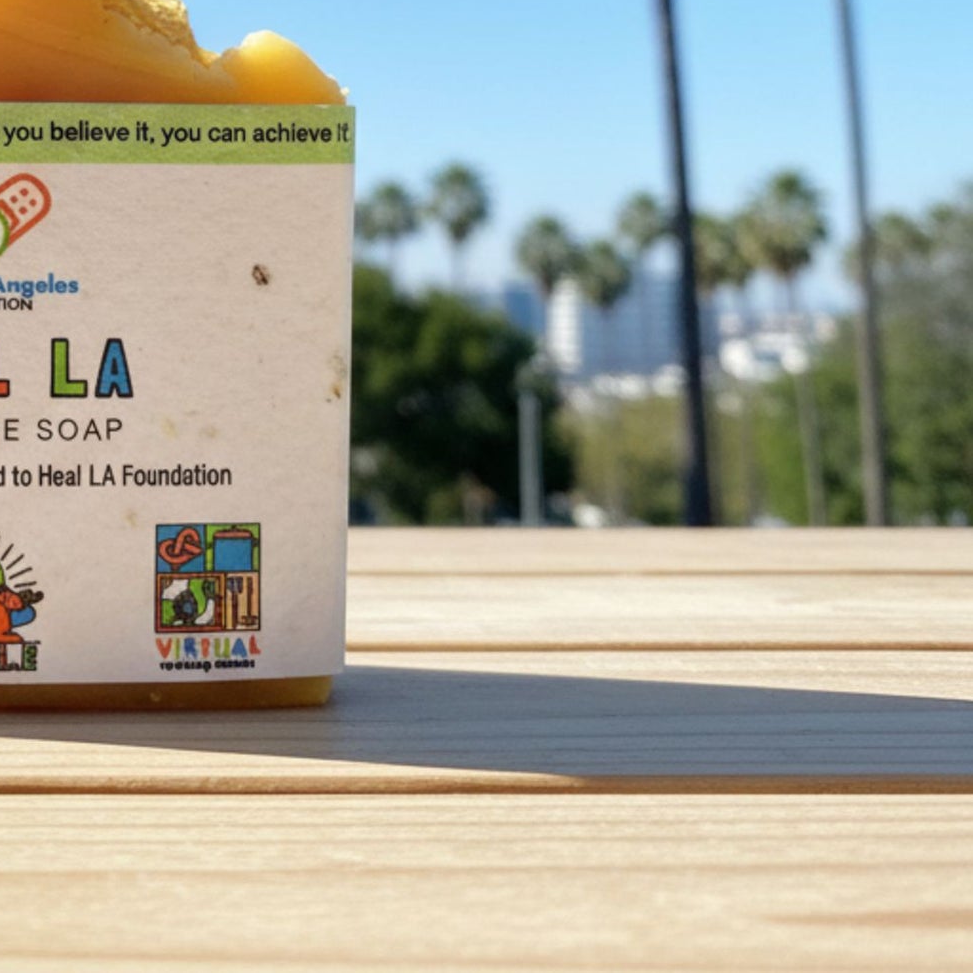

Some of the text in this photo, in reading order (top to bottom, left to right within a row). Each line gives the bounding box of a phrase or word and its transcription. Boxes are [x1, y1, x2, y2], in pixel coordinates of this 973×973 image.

[3, 125, 43, 146] you
[51, 122, 129, 141] believe
[136, 122, 154, 145] it,
[161, 126, 201, 147] you
[208, 127, 246, 142] can
[252, 124, 331, 142] achieve
[50, 337, 133, 398] LA
[37, 418, 123, 441] SOAP
[12, 466, 32, 488] to
[38, 465, 81, 488] Heal
[89, 466, 115, 487] LA
[123, 465, 232, 487] Foundation
